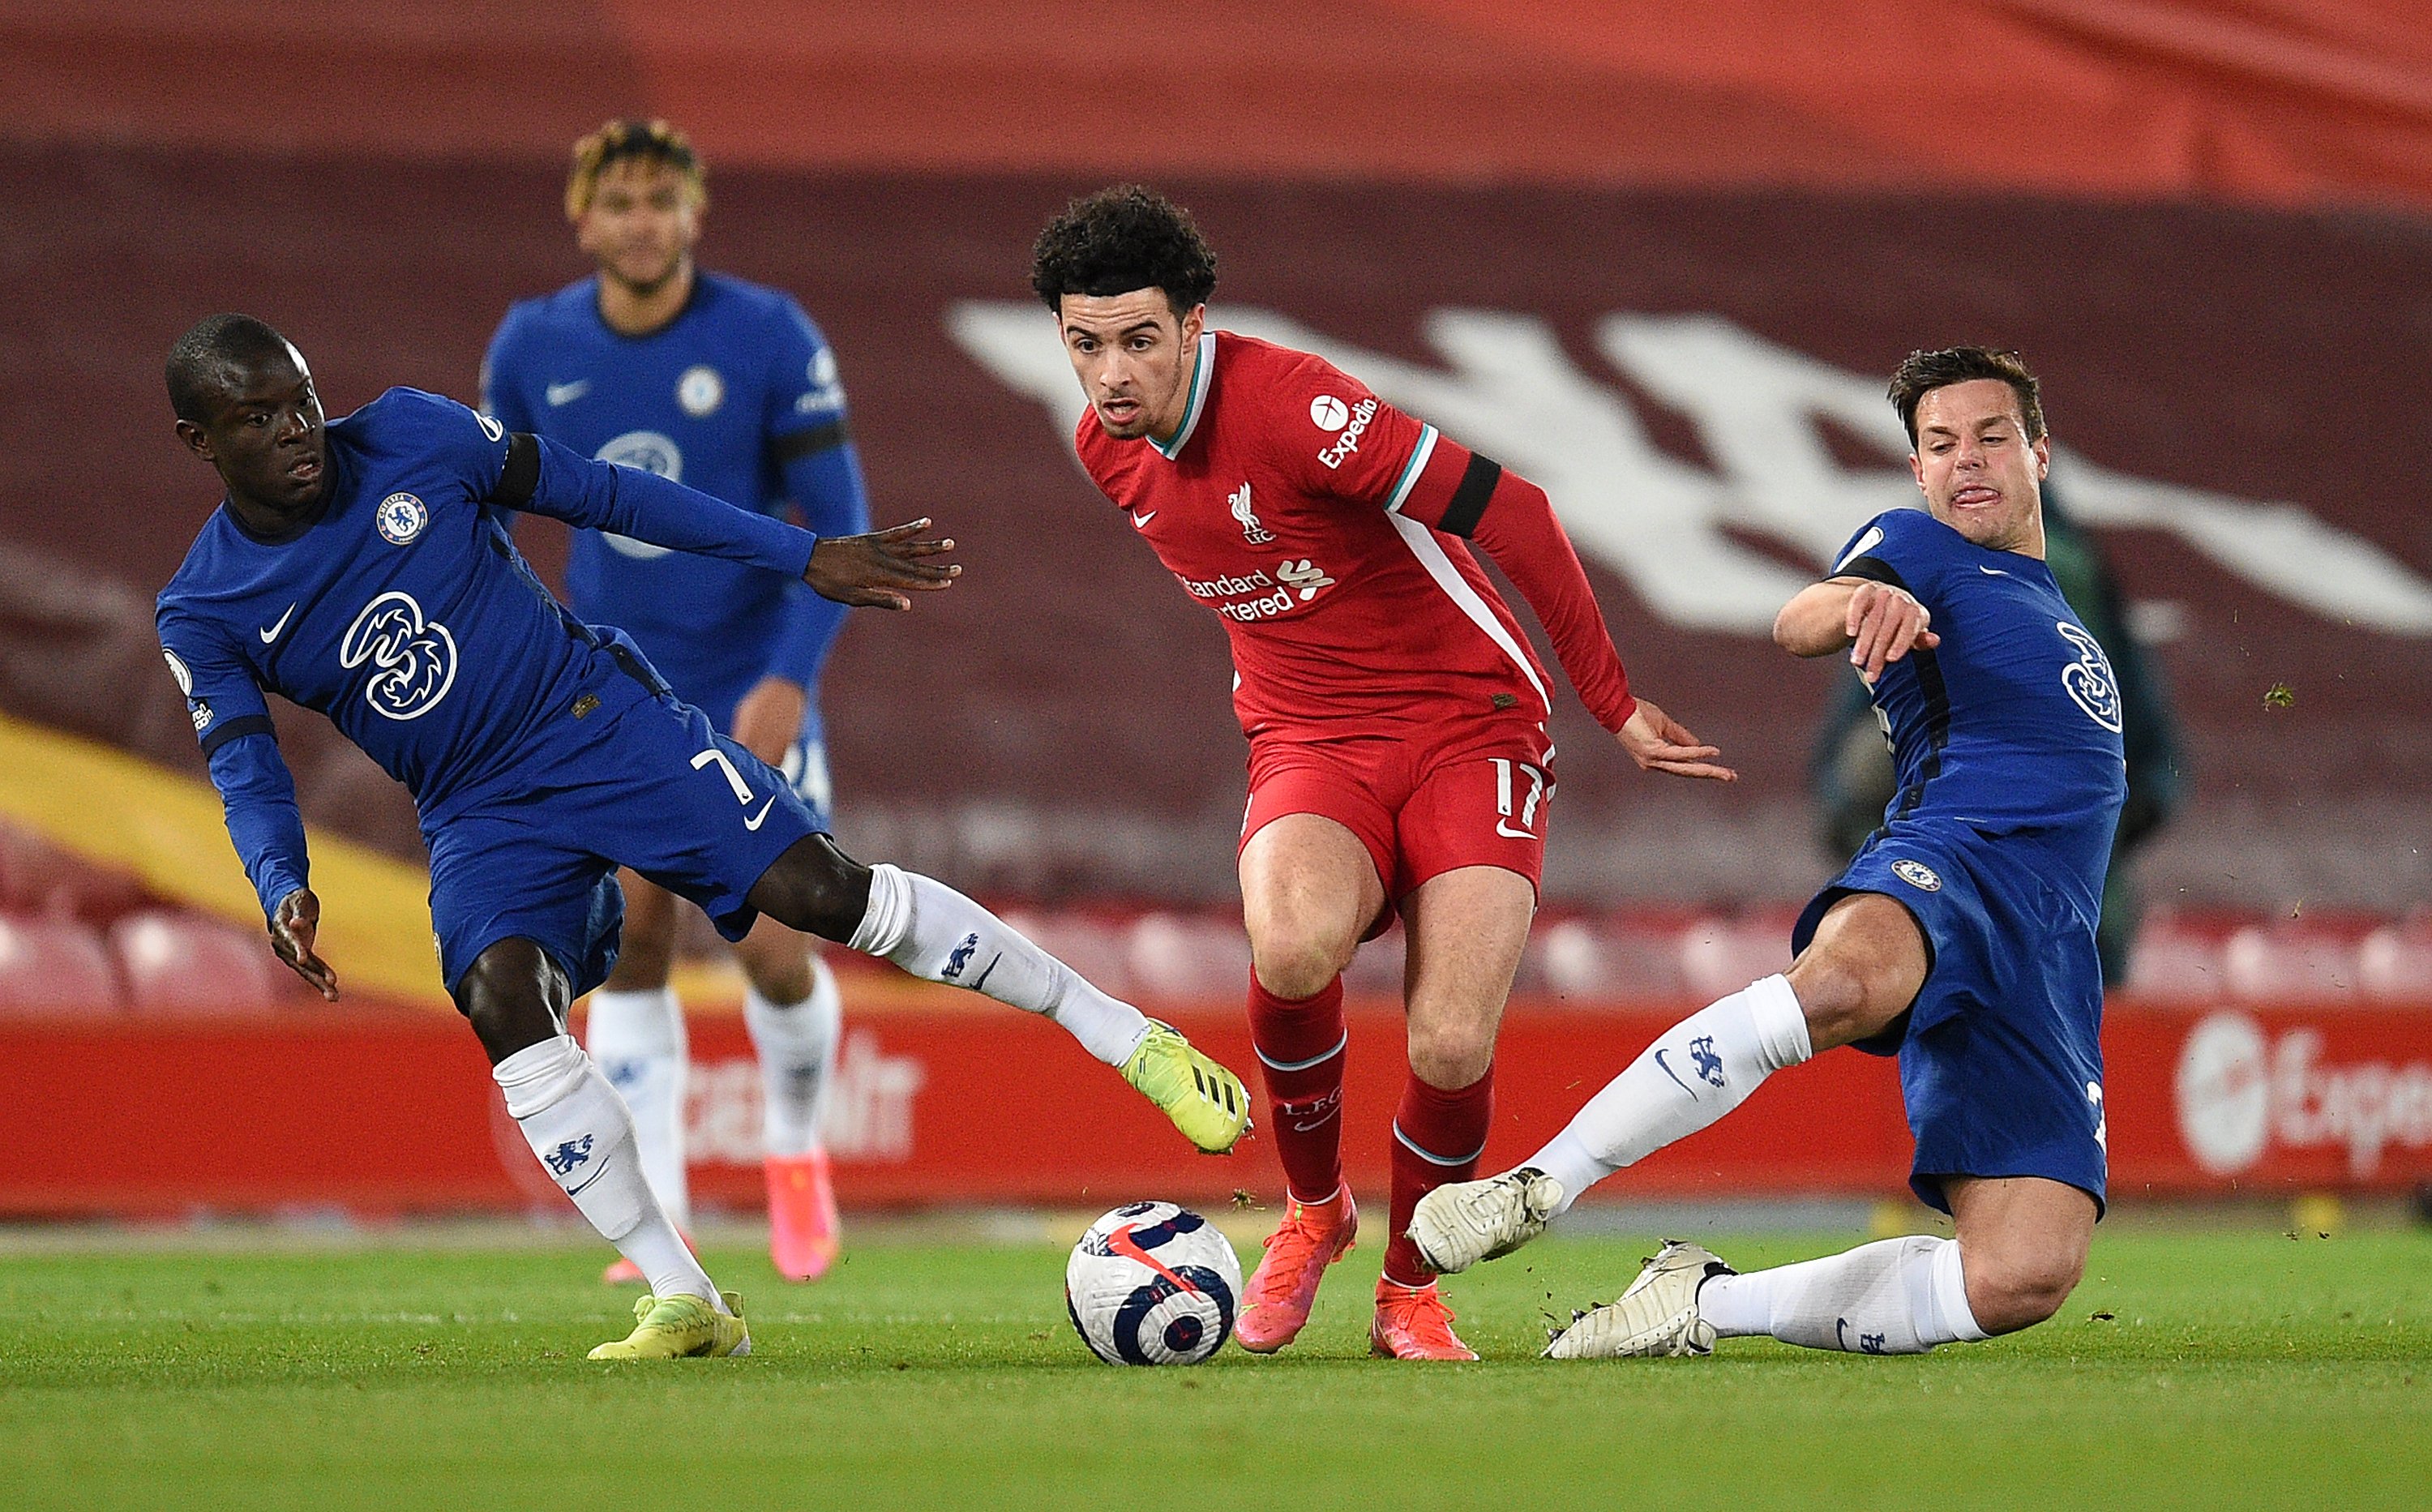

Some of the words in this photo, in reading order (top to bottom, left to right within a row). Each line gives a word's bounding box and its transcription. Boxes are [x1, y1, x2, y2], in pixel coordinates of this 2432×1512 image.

[1181, 569, 1274, 598] tandard
[1218, 585, 1295, 622] rtered
[689, 748, 755, 806] 7
